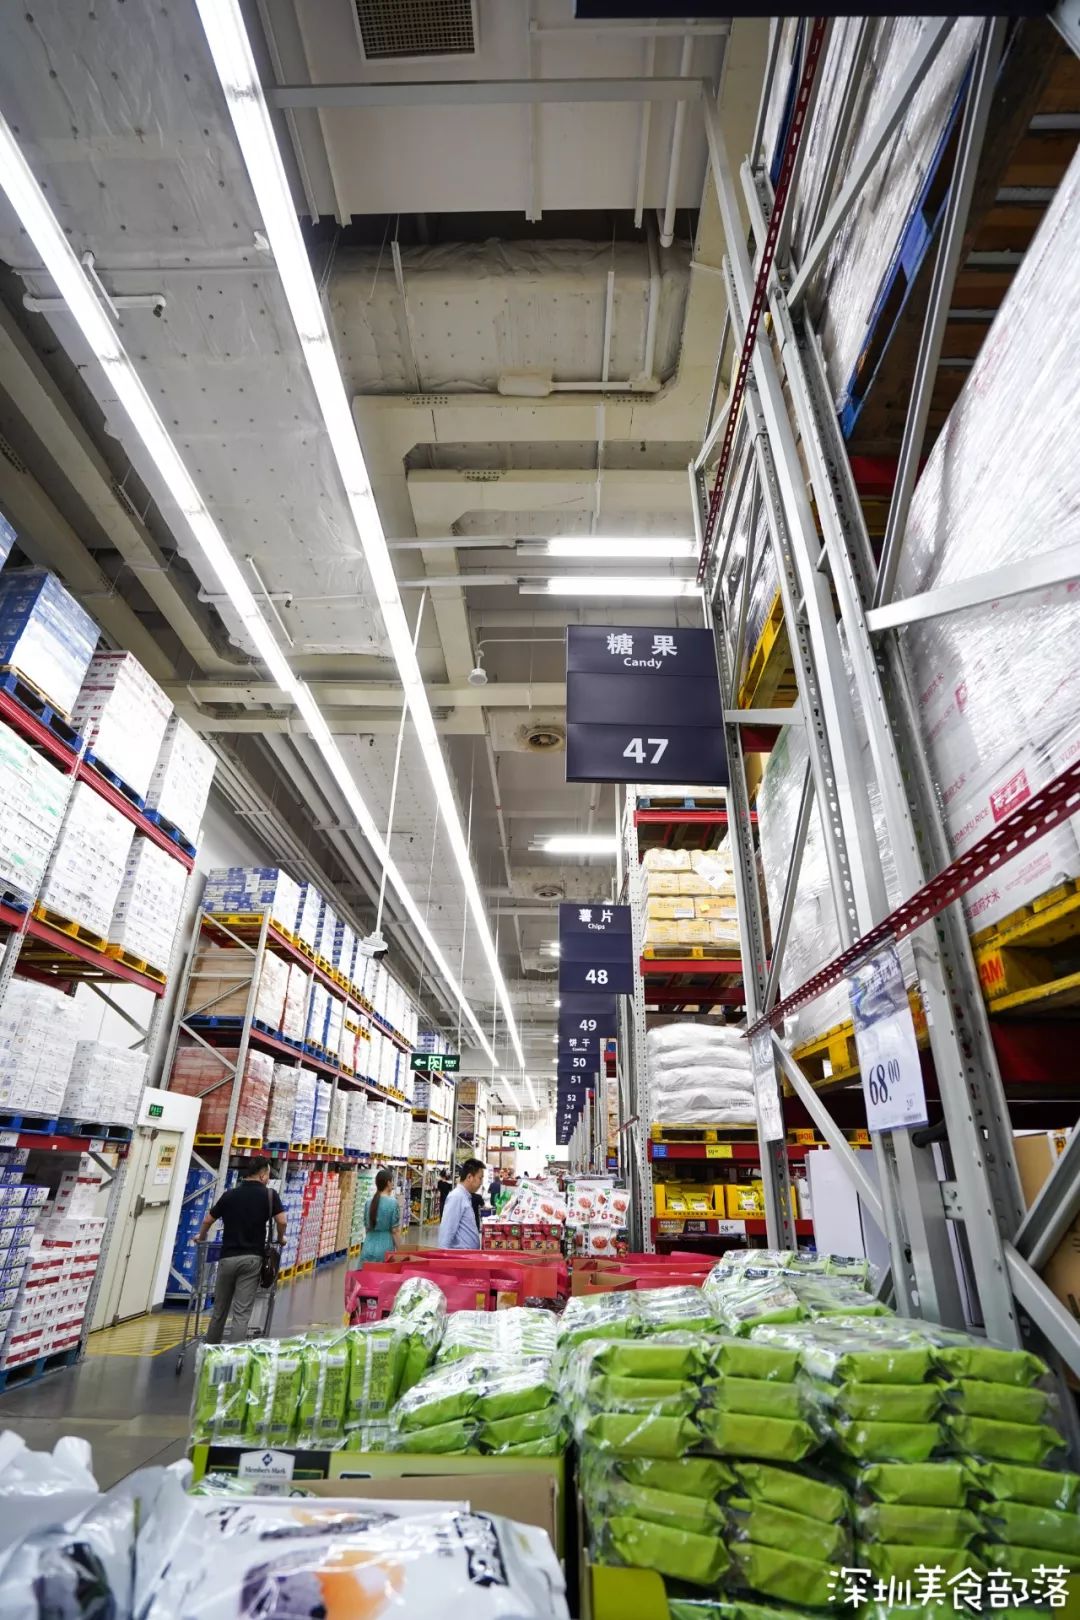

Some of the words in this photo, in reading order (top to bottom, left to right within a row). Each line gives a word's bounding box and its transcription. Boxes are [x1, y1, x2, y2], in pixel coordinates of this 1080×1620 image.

[606, 633, 678, 656] 糖果
[623, 657, 663, 669] Candy
[622, 738, 669, 764] 47
[578, 908, 614, 923] 薯片
[587, 923, 605, 931] Chips
[585, 969, 609, 984] 48
[579, 1019, 597, 1031] 49
[572, 1057, 587, 1068] 50
[570, 1075, 582, 1084] 51
[567, 1094, 577, 1102] 52
